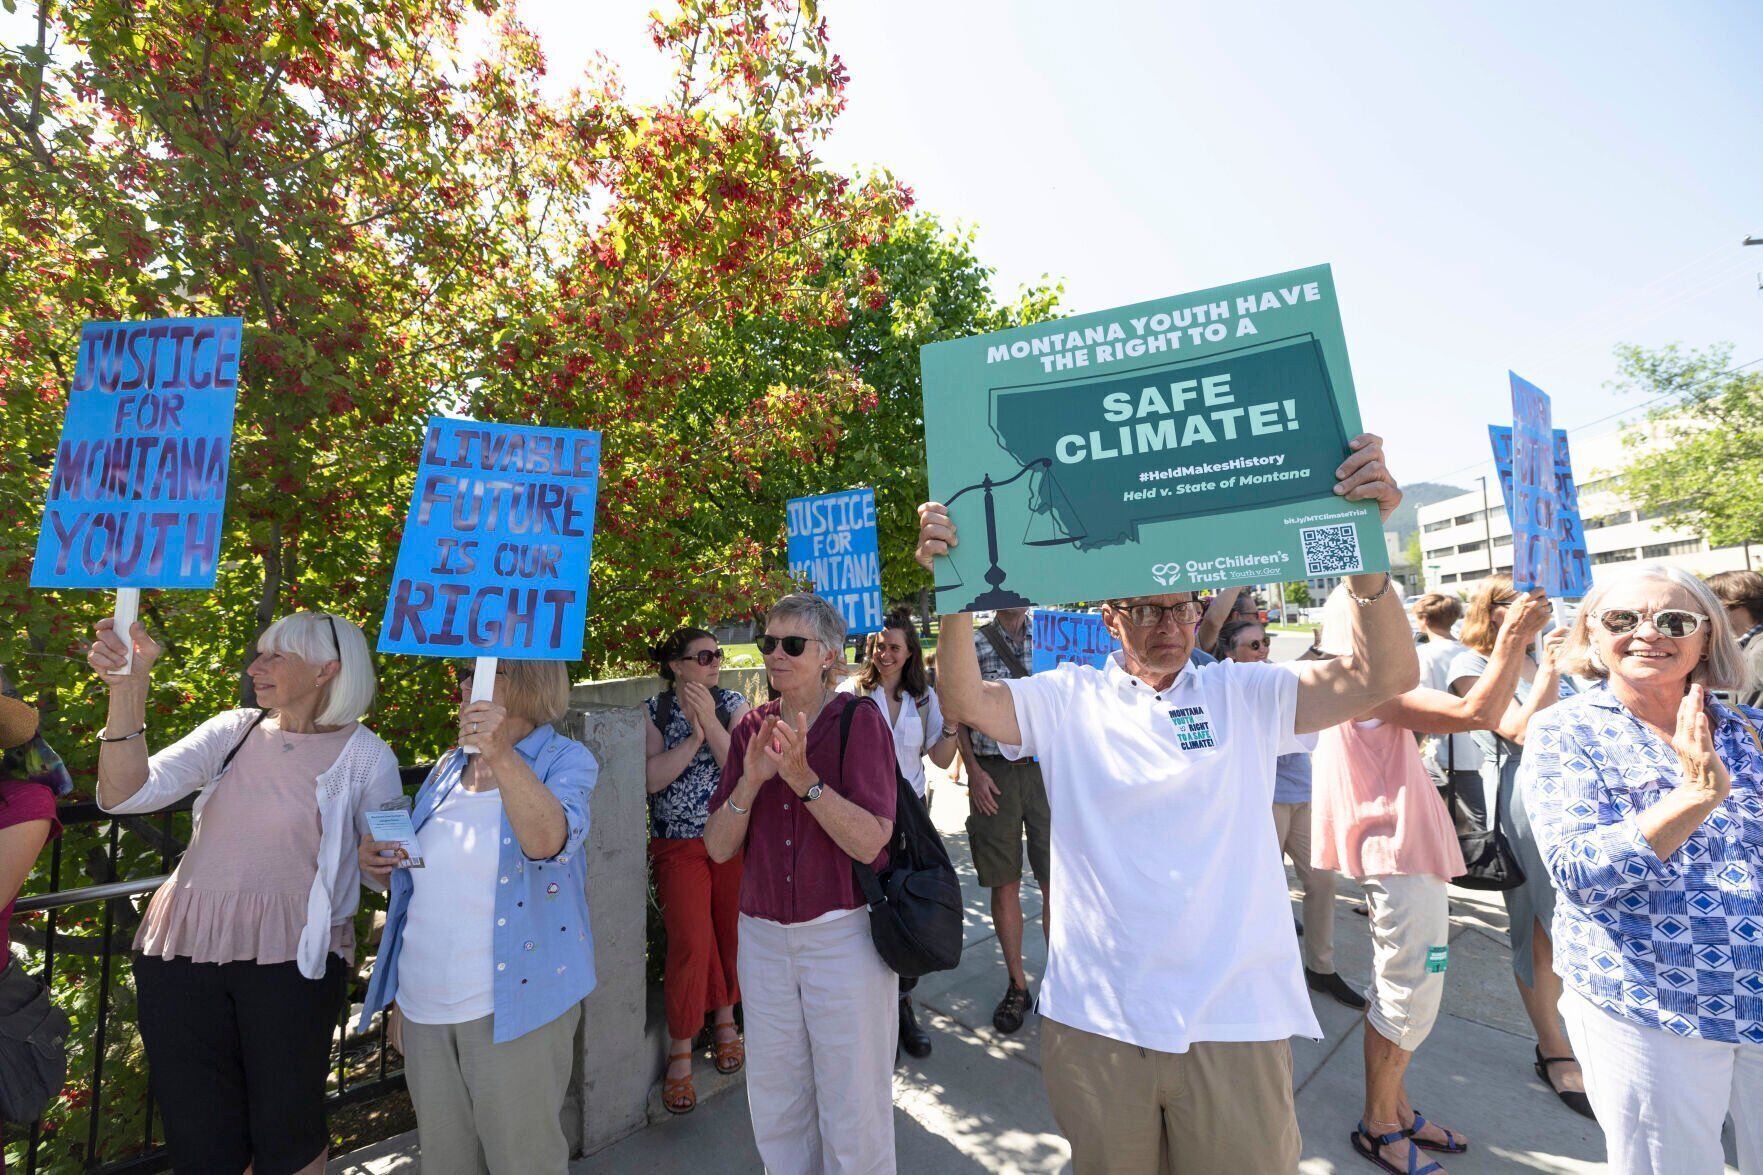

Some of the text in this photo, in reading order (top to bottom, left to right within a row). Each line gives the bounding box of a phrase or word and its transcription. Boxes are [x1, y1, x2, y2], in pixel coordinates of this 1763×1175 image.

[987, 282, 1321, 364] MONTANA YOUTH HAVE
[73, 326, 236, 393] JUSTICE
[1040, 317, 1258, 373] THE RIGHT TO A
[114, 393, 184, 433] FOR
[1102, 373, 1235, 422] SAFE
[1055, 399, 1299, 464] CLIMATE!
[51, 437, 224, 500] MONTANA
[425, 427, 594, 478] LIVABLE
[1139, 454, 1285, 482] #HeldMakesHistory
[1123, 468, 1311, 501] Held v. State of Montana
[417, 474, 589, 537] FUTURE
[787, 493, 875, 537] JUSTICE
[1283, 509, 1367, 525] bit.ly/MTClimateTrial
[51, 511, 217, 578] YOUTH
[431, 538, 562, 579] IS OUR
[813, 532, 852, 556] FOR
[1188, 570, 1227, 583] Trust
[389, 579, 576, 648] RIGHT
[828, 591, 881, 628] UTH
[1168, 707, 1204, 718] MONTANA
[1172, 716, 1194, 725] YOUTH
[1188, 722, 1209, 732] RIGHT
[1177, 733, 1188, 741] TO
[1193, 730, 1211, 740] SAFE
[1181, 739, 1214, 750] CLIMATE!
